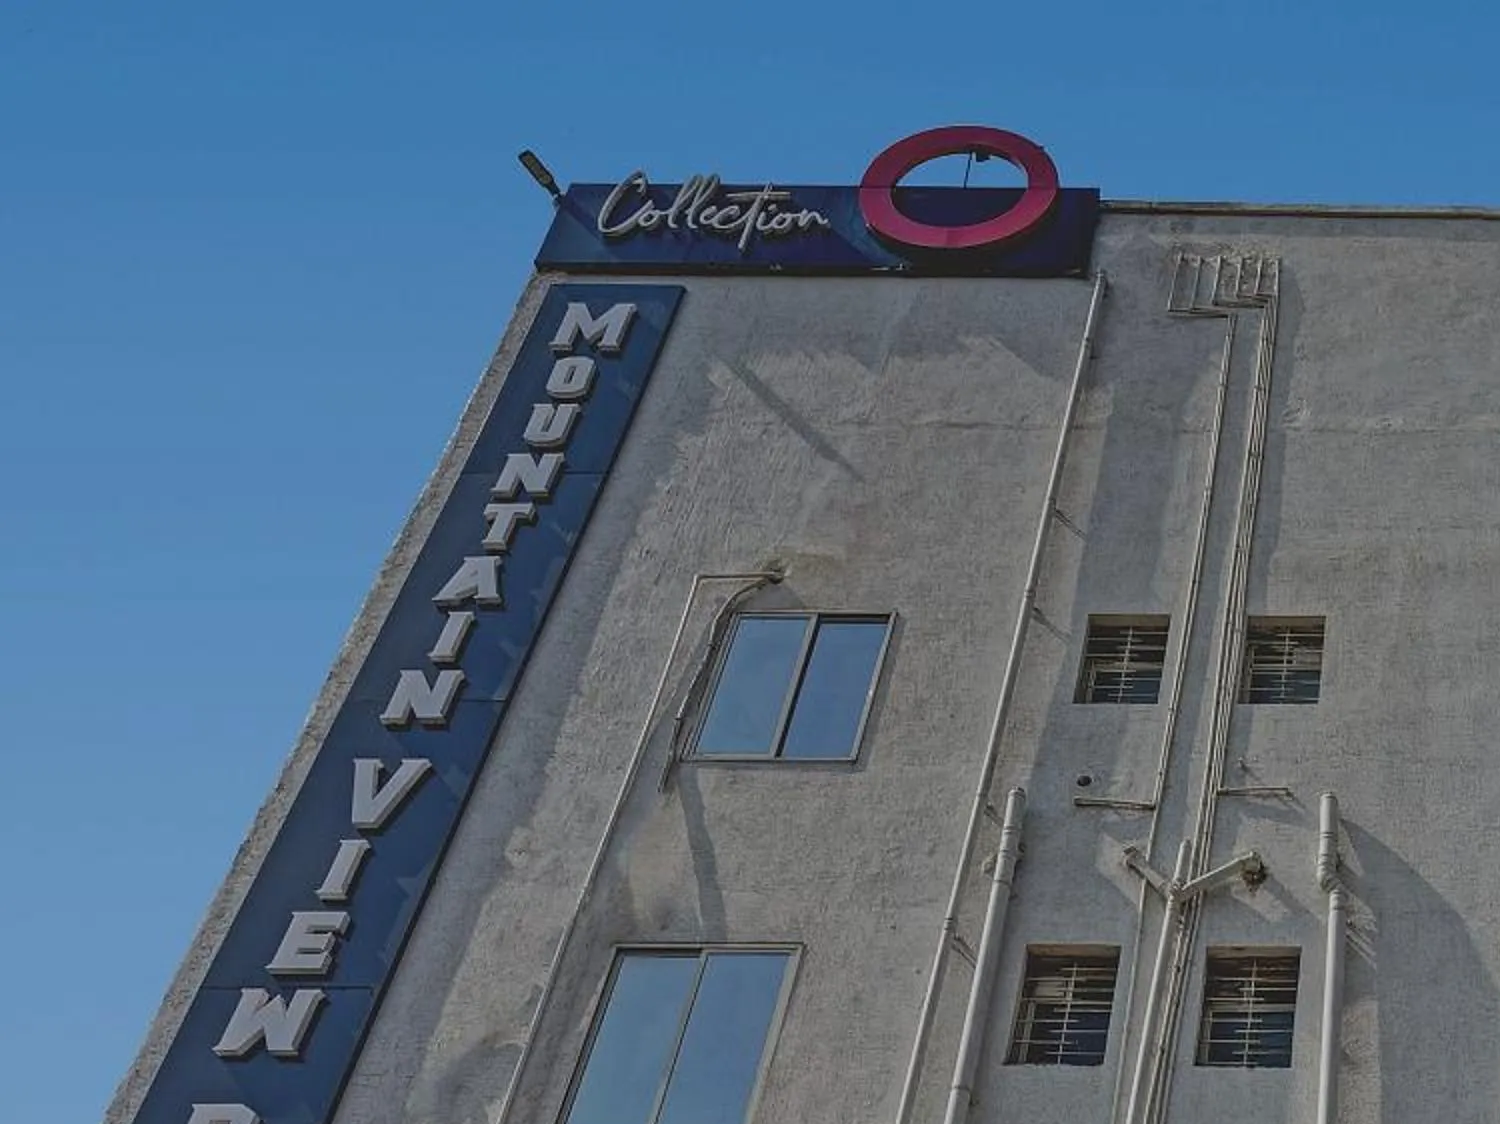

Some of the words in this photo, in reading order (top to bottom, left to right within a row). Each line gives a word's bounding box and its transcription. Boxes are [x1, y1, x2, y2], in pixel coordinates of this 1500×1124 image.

[598, 168, 829, 251] Collection
[379, 302, 638, 726] MOUNTAIN
[213, 758, 433, 1057] VIEW
